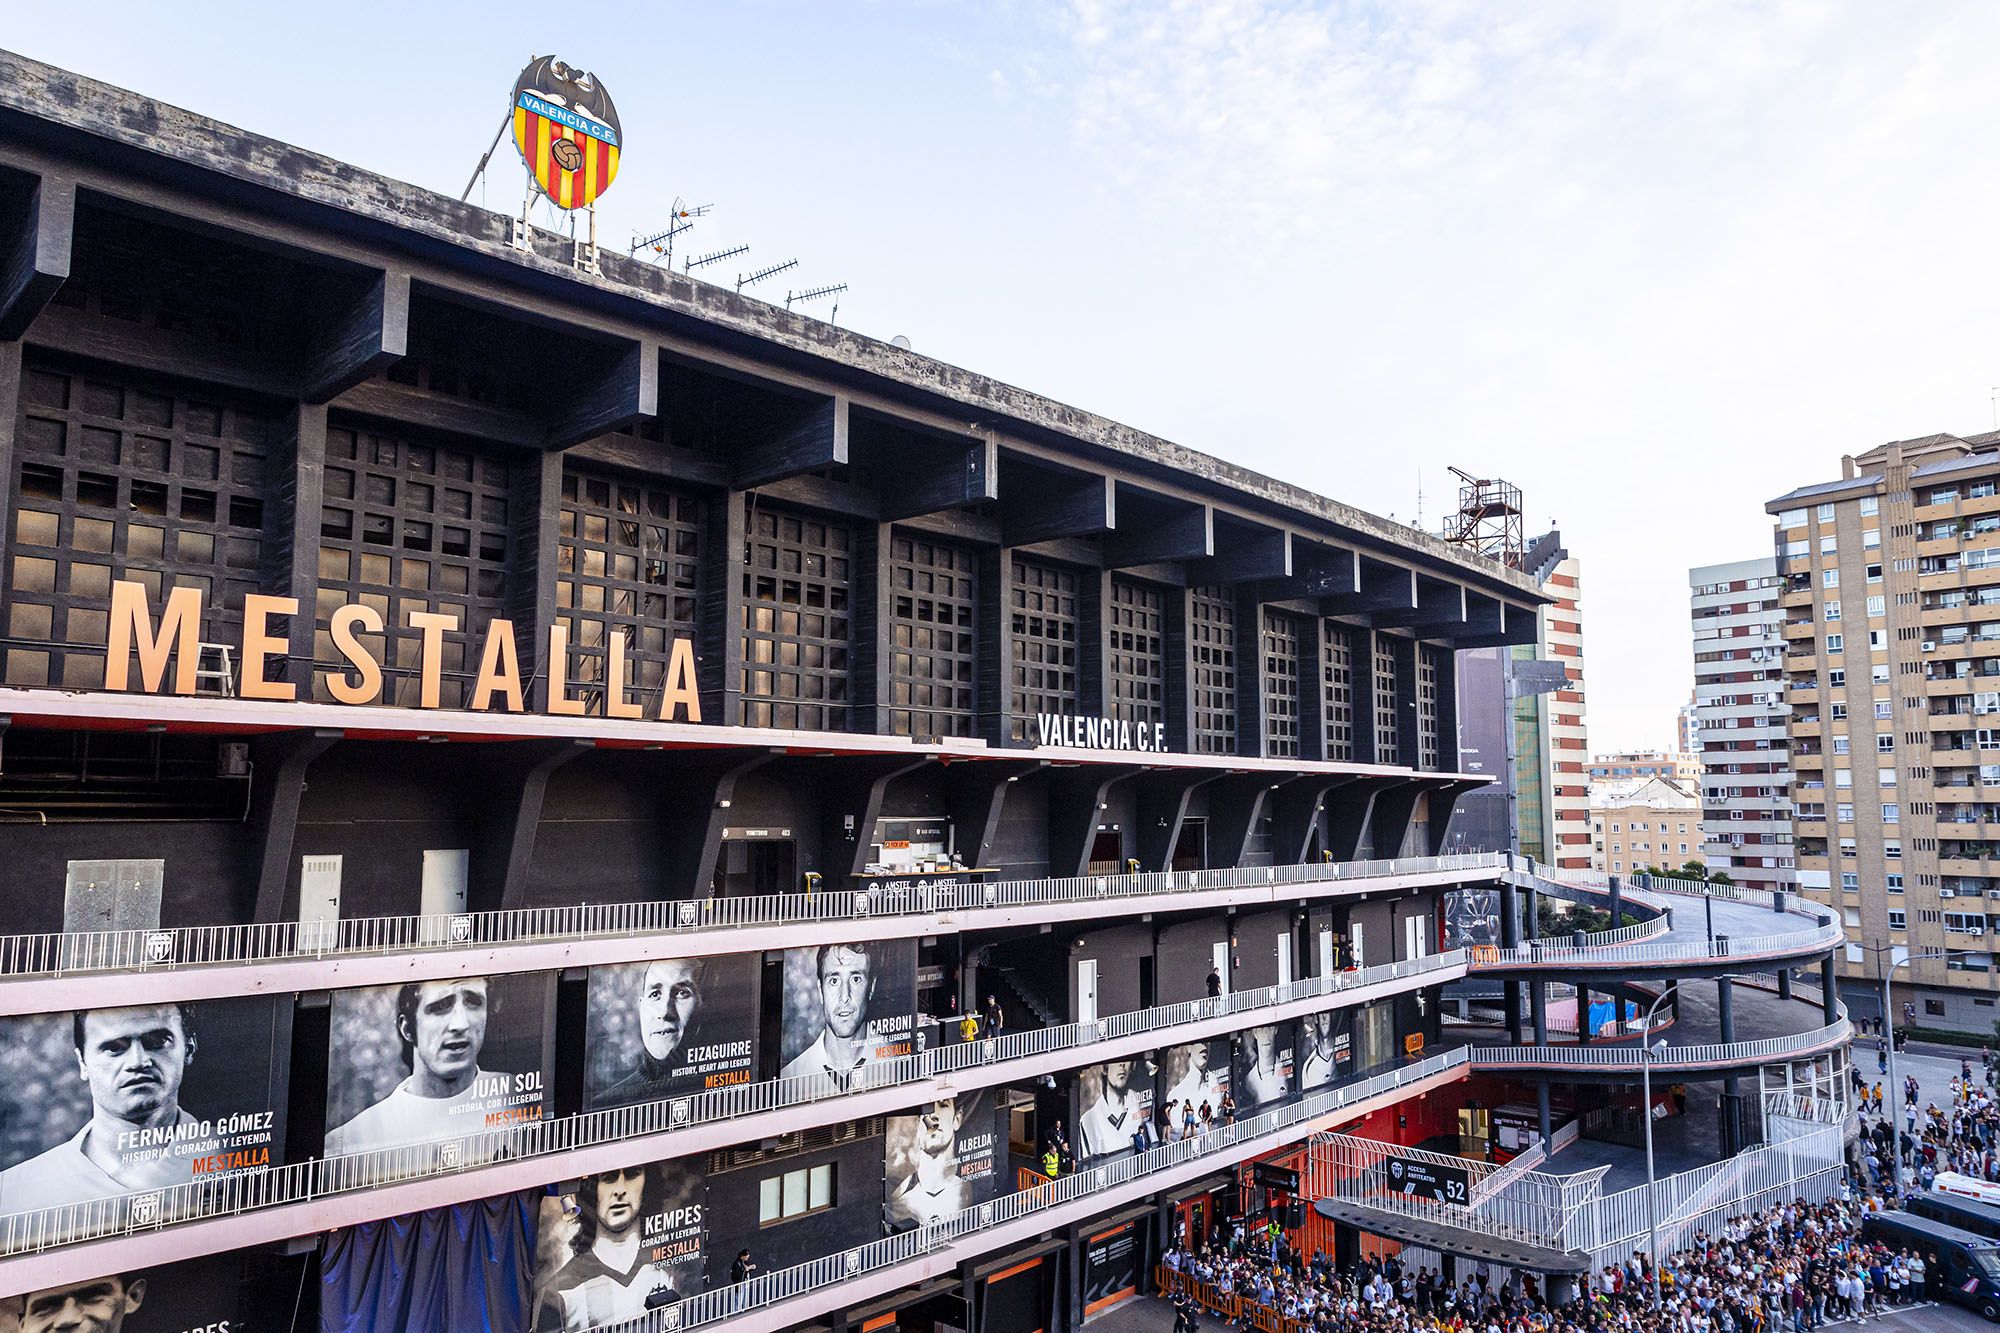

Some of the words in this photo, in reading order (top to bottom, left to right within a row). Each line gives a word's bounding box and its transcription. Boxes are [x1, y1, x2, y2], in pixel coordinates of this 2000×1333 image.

[524, 95, 589, 132] VALENCIA
[592, 125, 615, 142] C.F.
[105, 580, 702, 722] MESTALLA
[1038, 713, 1131, 750] VALENCIA
[1137, 721, 1168, 752] C.F.
[870, 1014, 912, 1036] CARBONI
[688, 1040, 752, 1064] EIZAGUIRRE
[876, 1042, 912, 1059] MESTALLA
[672, 1065, 698, 1078] HISTORY,
[698, 1062, 716, 1073] HEART
[718, 1061, 728, 1070] AND
[730, 1058, 751, 1068] LEGEND
[705, 1070, 750, 1088] MESTALLA
[471, 1076, 510, 1100] JUAN
[515, 1071, 544, 1092] SOL
[486, 1098, 502, 1110] COR
[508, 1092, 543, 1106] LLEGENDA
[485, 1106, 543, 1128] MESTALLA
[117, 1120, 211, 1150] FERNANDO
[217, 1112, 274, 1135] GÓMEZ
[122, 1147, 171, 1164] HISTORIA,
[174, 1139, 220, 1156] CORAZÓN
[222, 1138, 230, 1148] Y
[230, 1132, 272, 1148] LEYENDA
[958, 1132, 992, 1154] ALBELDA
[192, 1147, 270, 1175] MESTALLA
[961, 1158, 992, 1176] MESTALLA
[1407, 1164, 1426, 1174] ACCESO
[1407, 1173, 1436, 1182] ANFITEATRO
[1446, 1180, 1465, 1200] 52
[645, 1204, 702, 1236] KEMPES
[641, 1232, 670, 1248] CORAZÓN
[670, 1232, 674, 1240] Y
[675, 1226, 701, 1240] LEYENDA
[652, 1238, 700, 1262] MESTALLA
[652, 1250, 700, 1270] FOREVERTOUR
